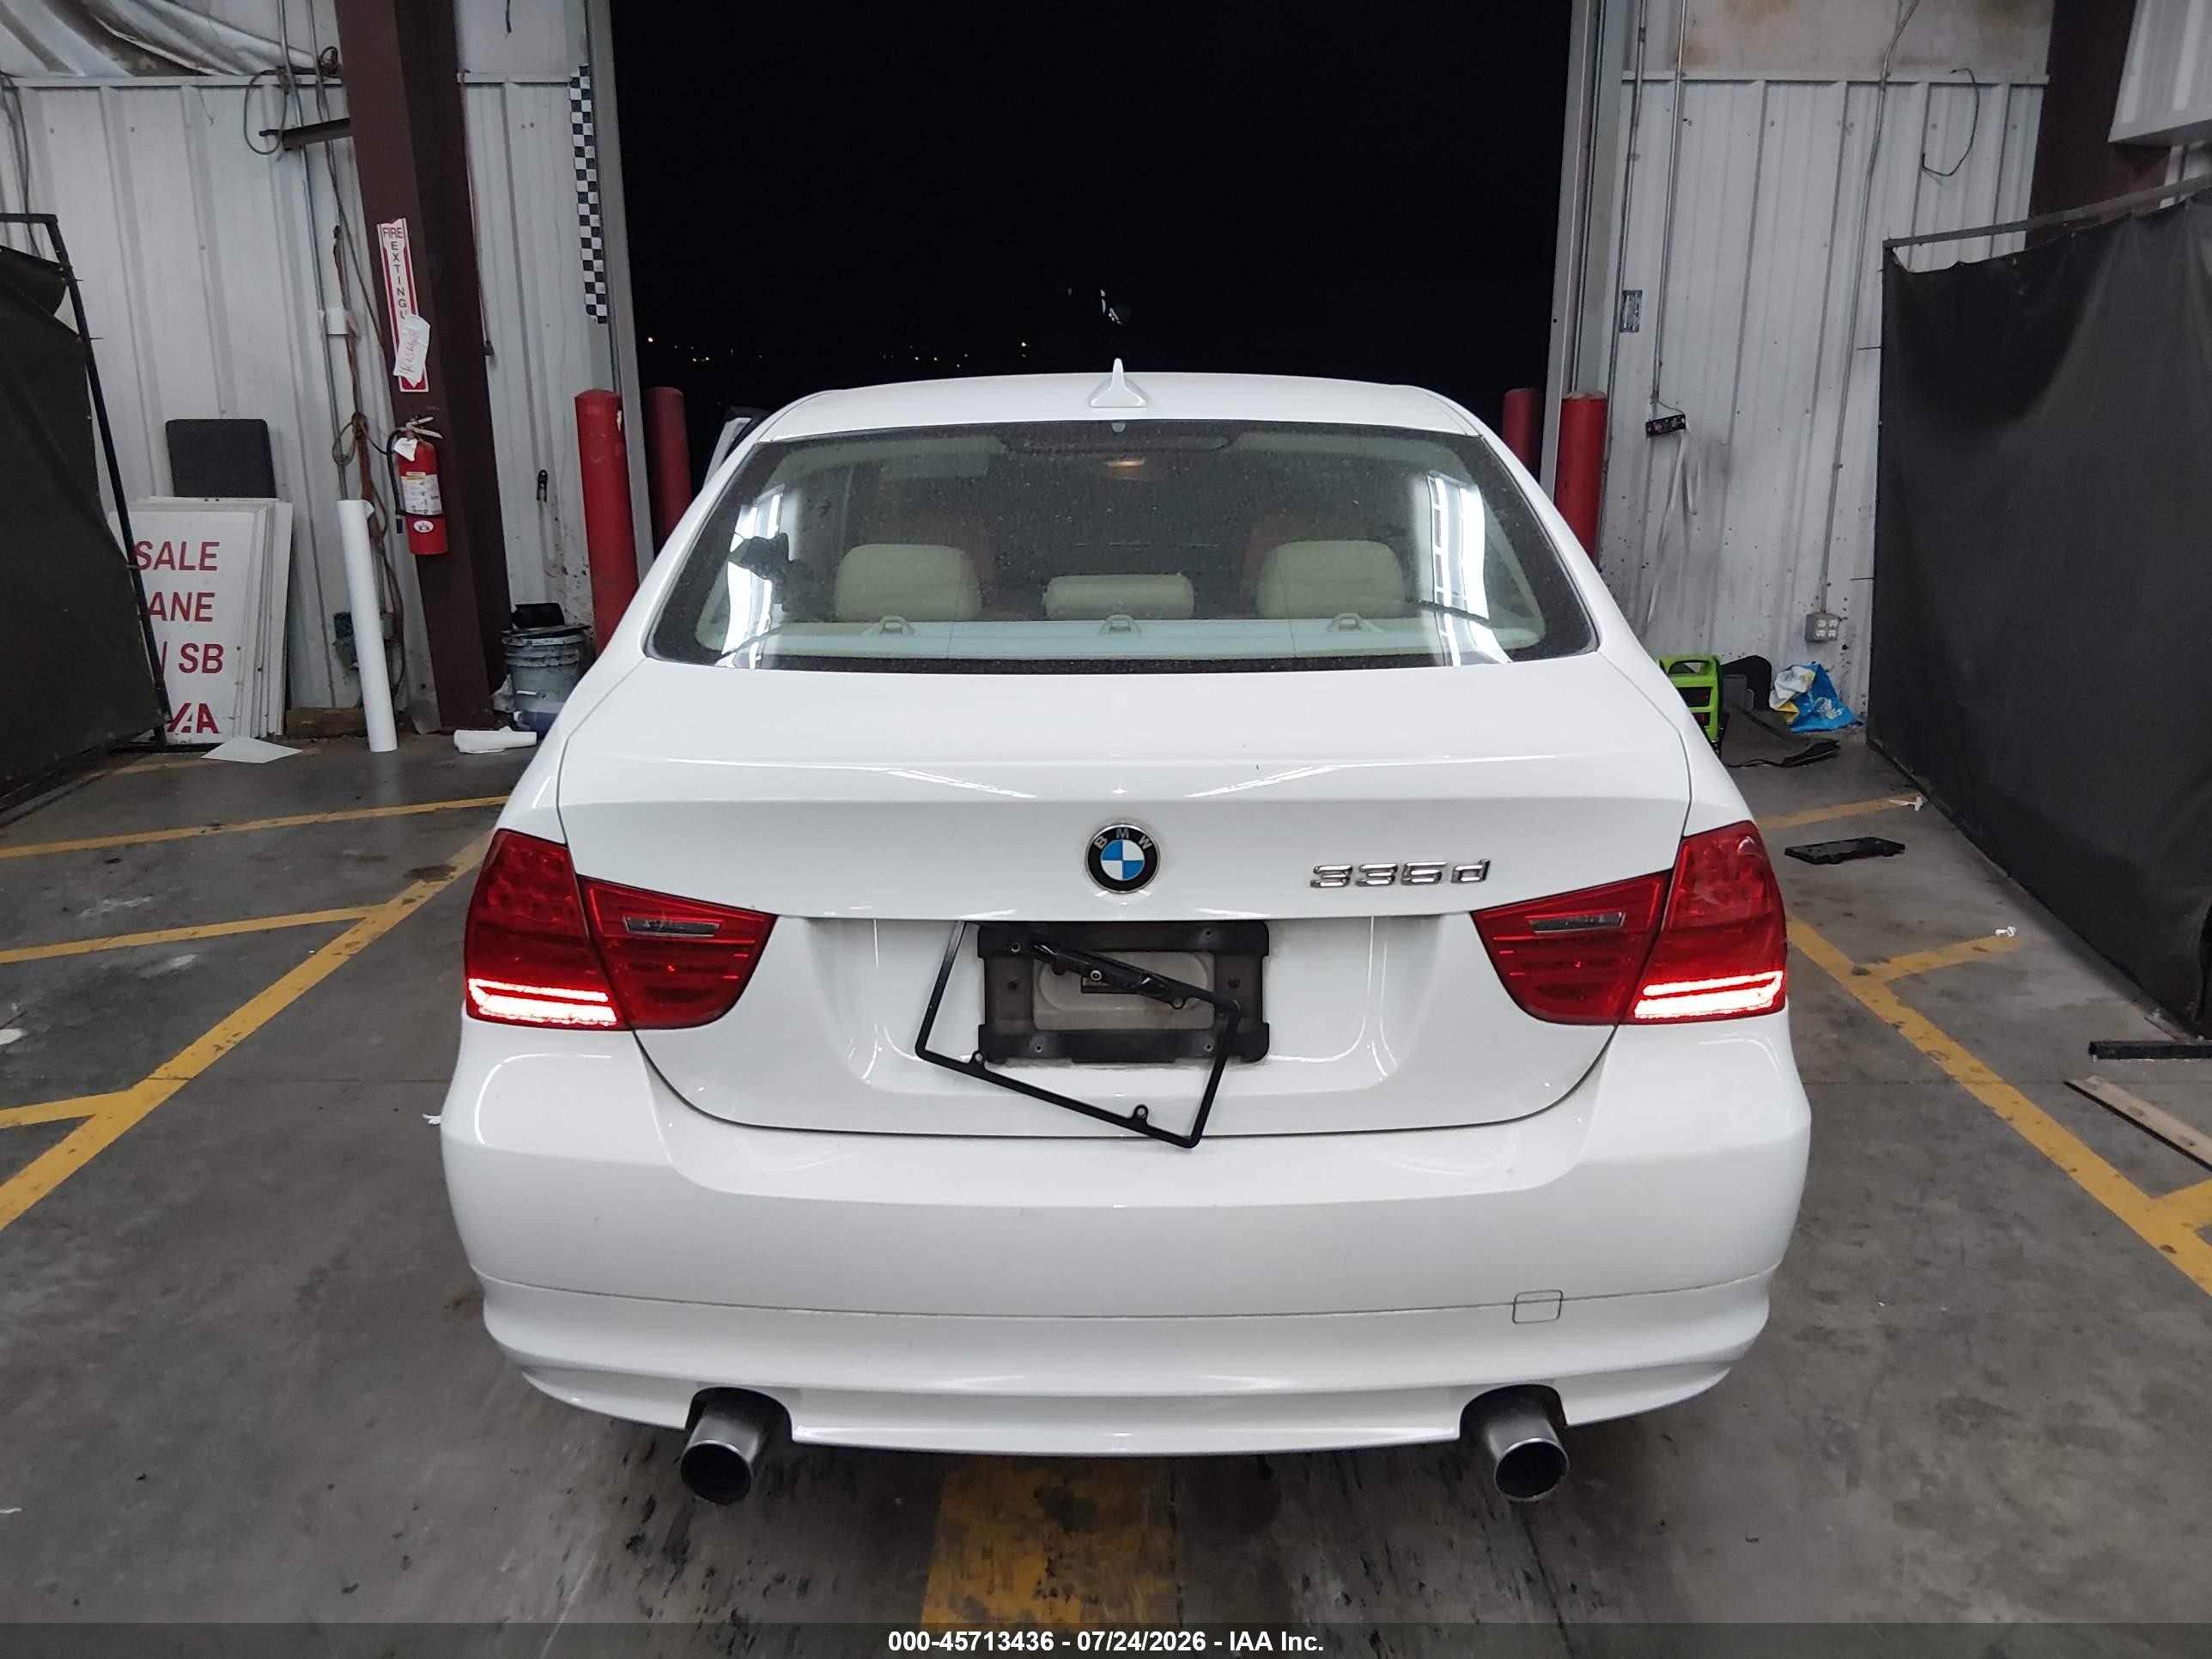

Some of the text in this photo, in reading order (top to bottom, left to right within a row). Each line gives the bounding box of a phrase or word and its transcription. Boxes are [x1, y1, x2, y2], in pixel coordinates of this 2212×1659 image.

[383, 227, 404, 239] FIRE
[391, 240, 408, 319] EXTINGU
[133, 540, 221, 571] SALE
[149, 591, 216, 623] ANE
[178, 642, 224, 674] SB
[1093, 828, 1153, 850] BMW
[1310, 859, 1492, 888] 335d
